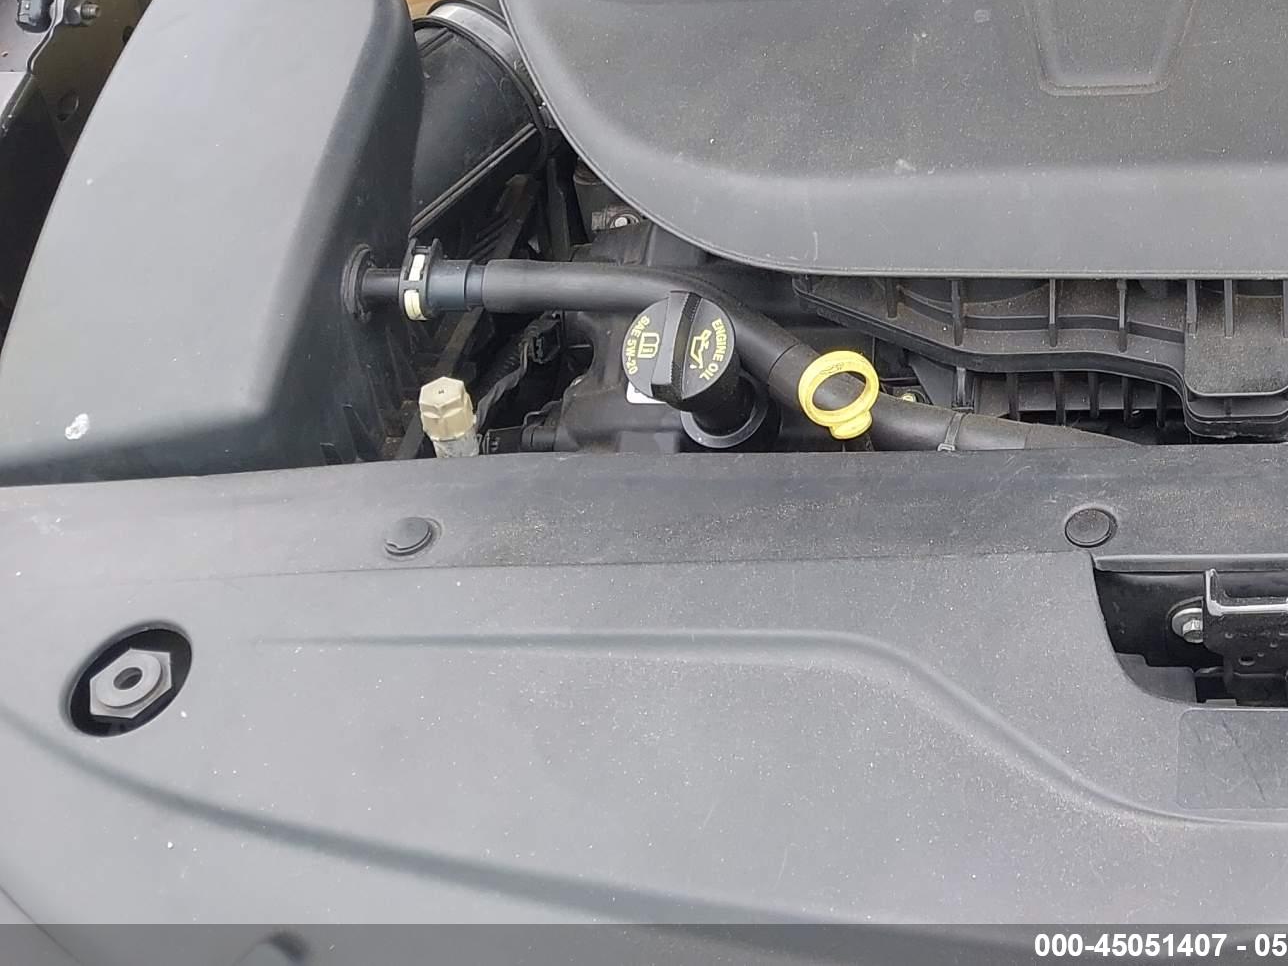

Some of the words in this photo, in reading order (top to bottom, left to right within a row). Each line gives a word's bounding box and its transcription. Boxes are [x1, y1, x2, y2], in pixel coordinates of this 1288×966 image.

[630, 315, 651, 338] SAE
[711, 318, 728, 363] ENGINE
[625, 338, 639, 375] 5W-20
[699, 362, 719, 381] OIL
